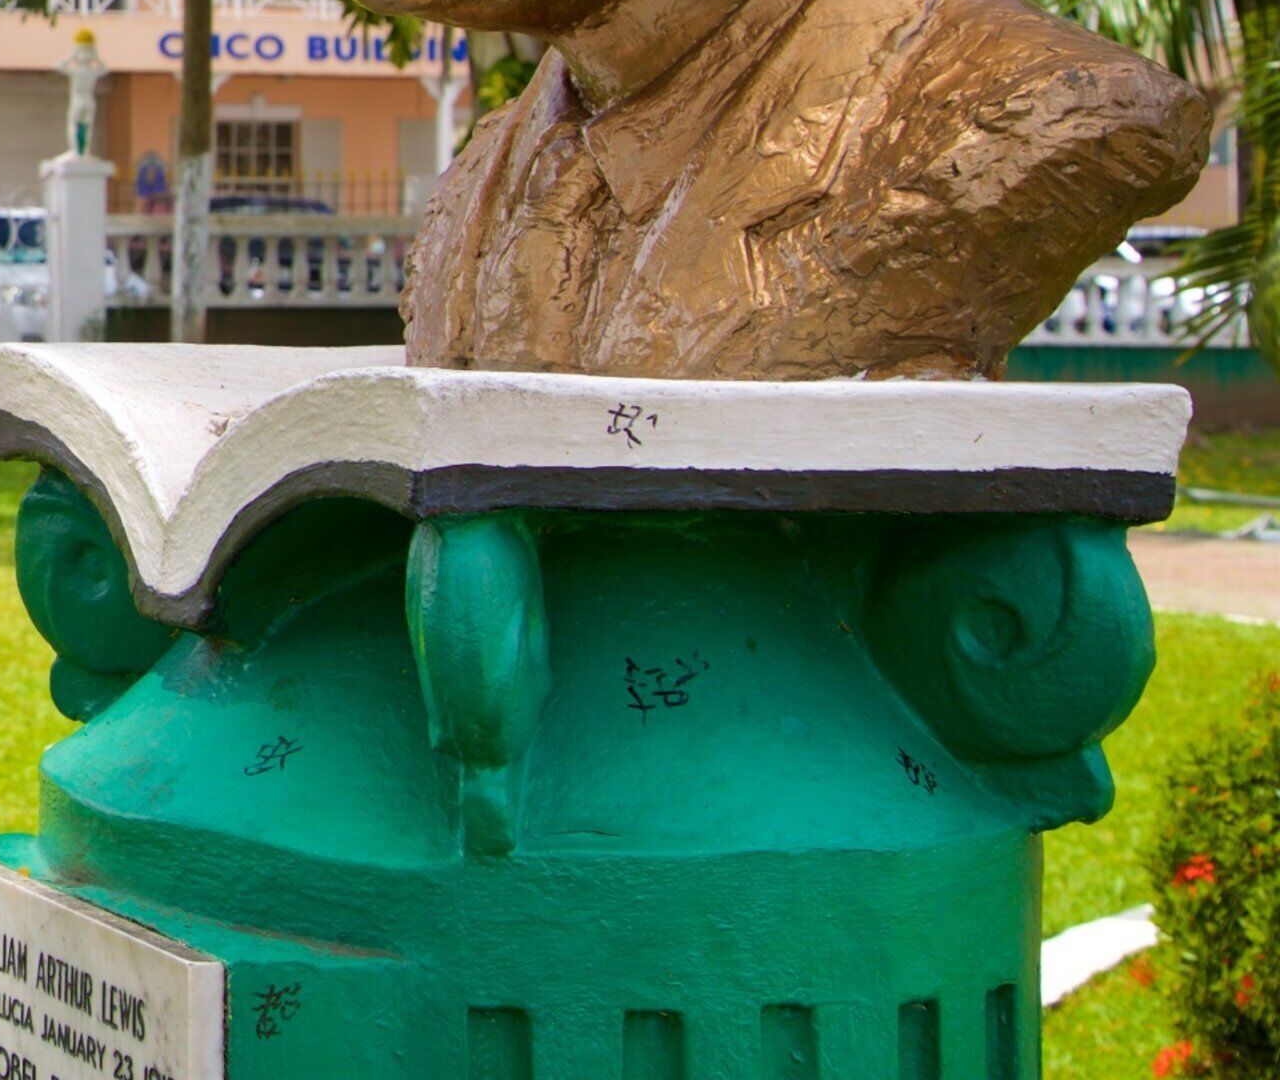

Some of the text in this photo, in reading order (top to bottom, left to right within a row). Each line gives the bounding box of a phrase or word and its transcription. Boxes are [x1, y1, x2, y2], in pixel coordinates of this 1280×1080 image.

[159, 32, 285, 59] CICO
[36, 951, 93, 1017] ARTHUR
[102, 981, 145, 1042] LEWIS
[41, 1013, 106, 1072] JANUARY
[113, 1049, 133, 1080] 23
